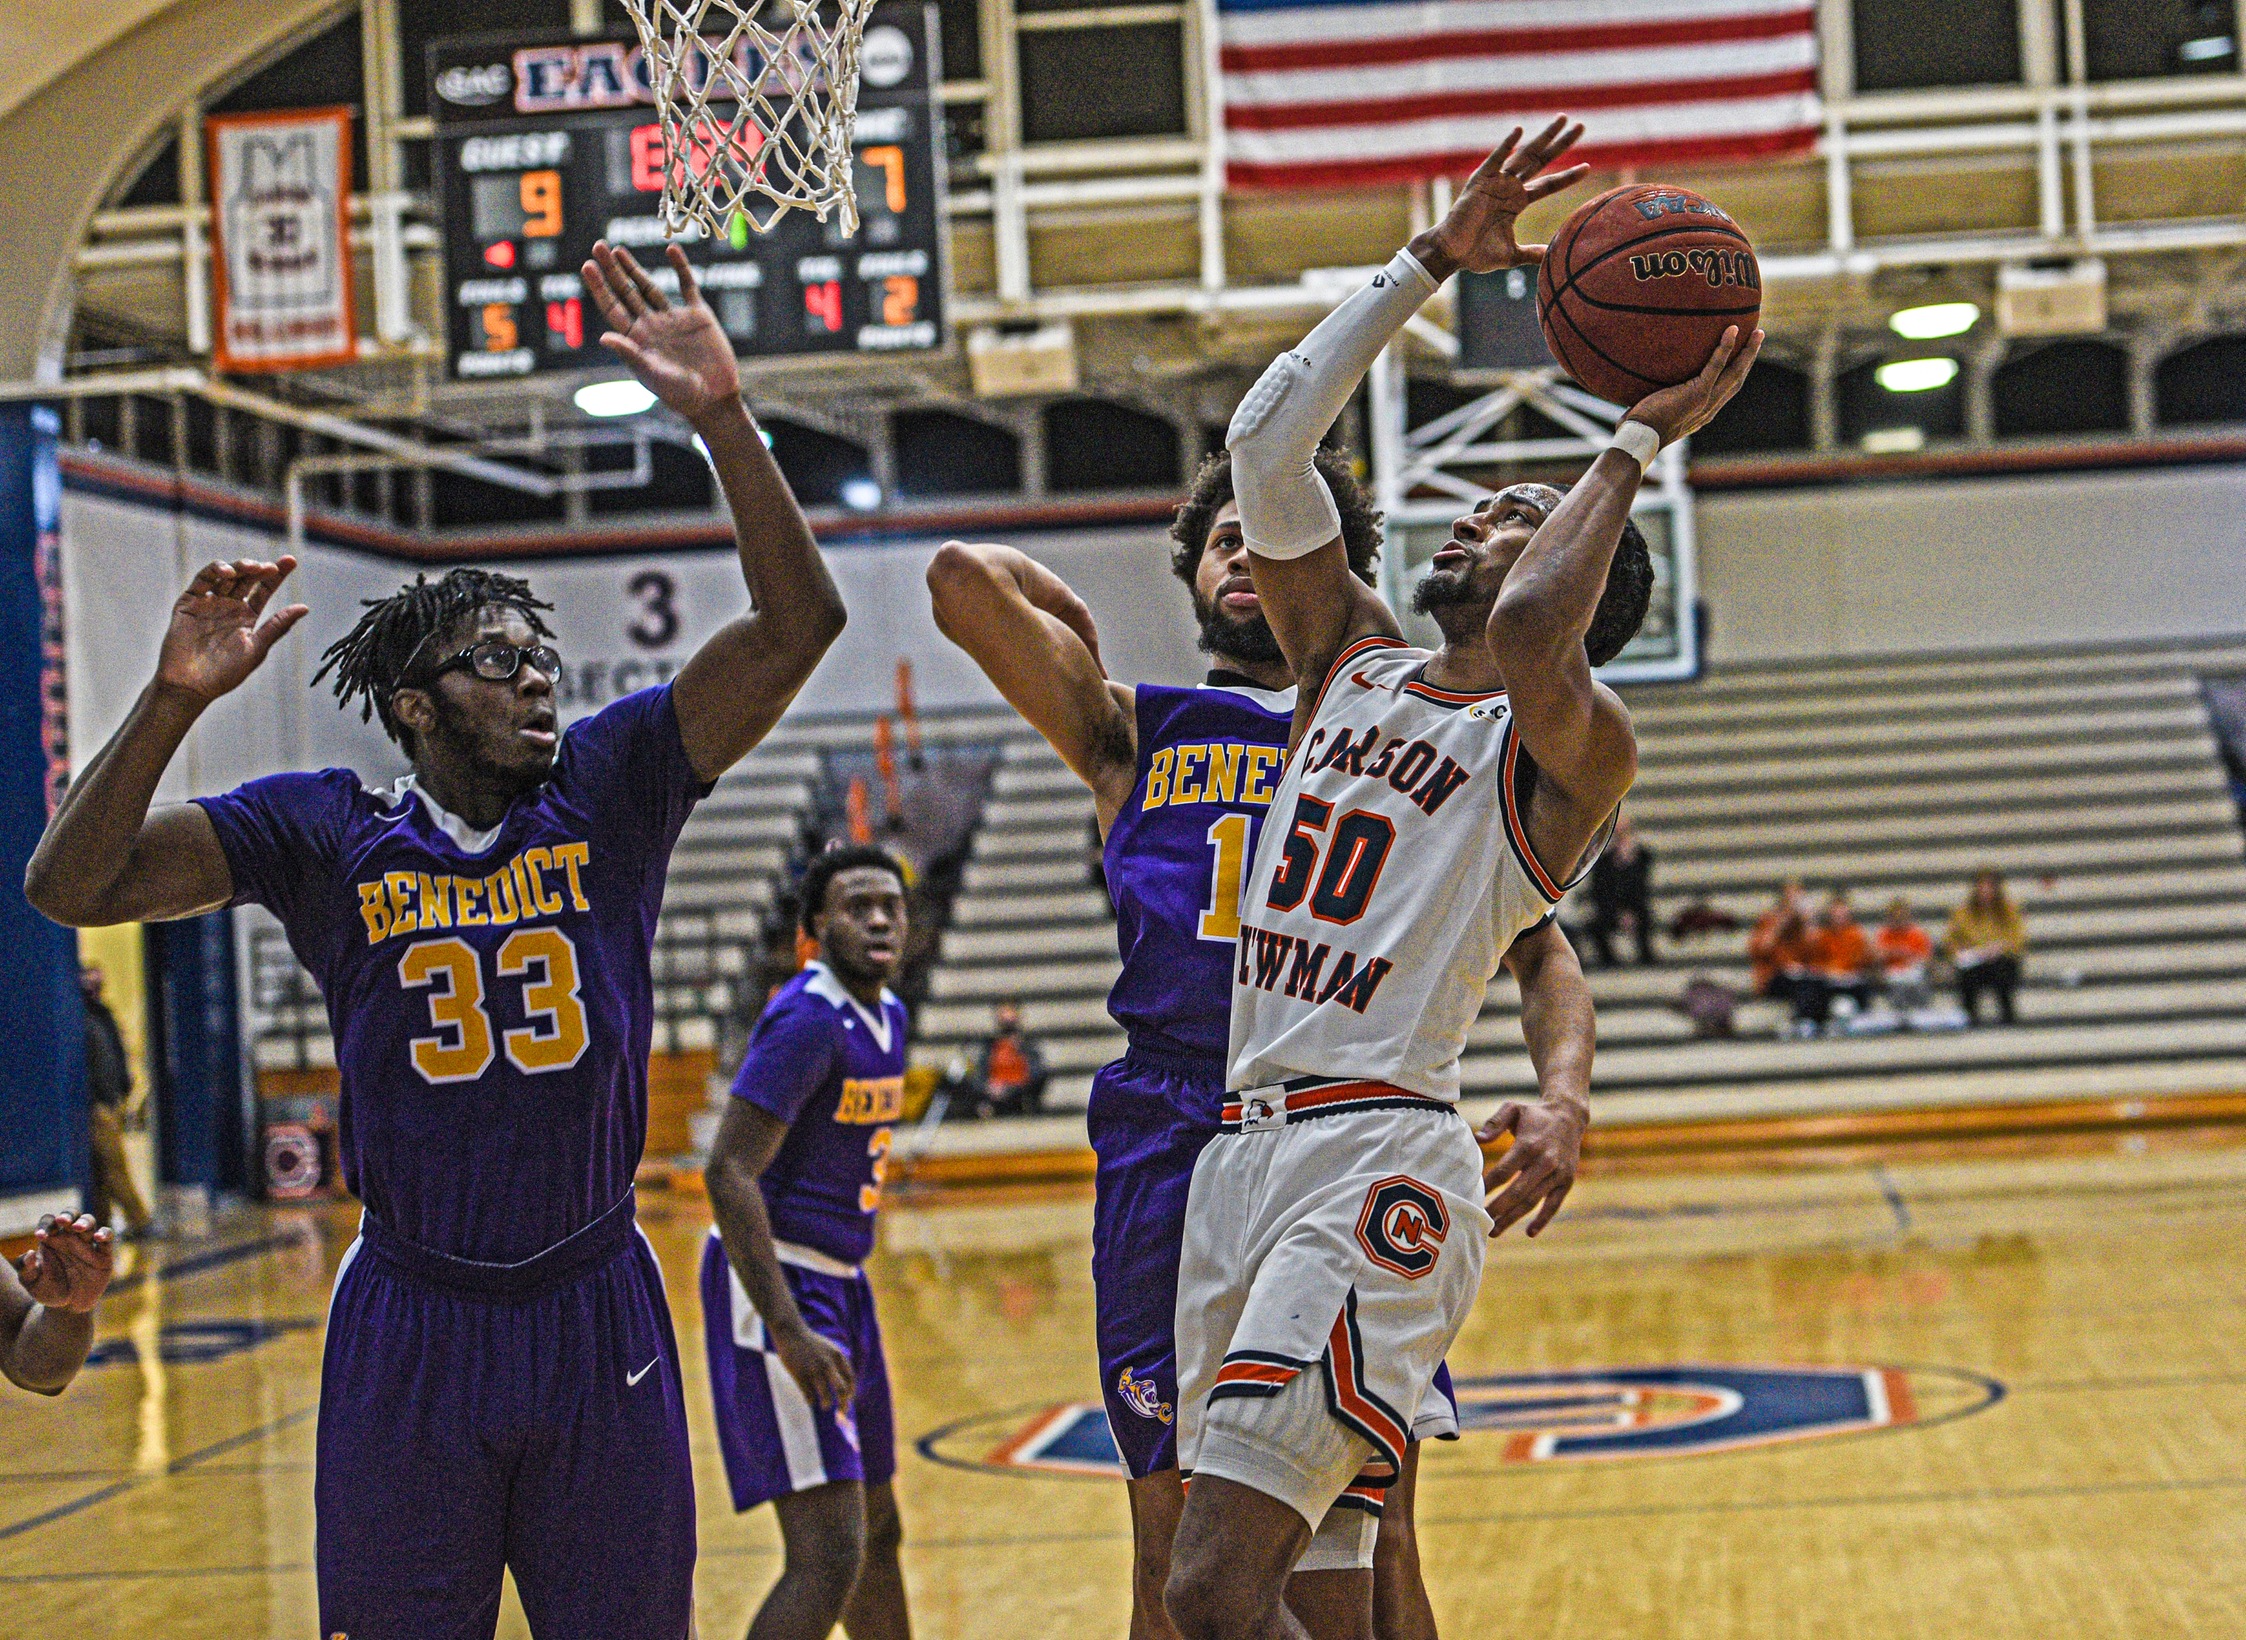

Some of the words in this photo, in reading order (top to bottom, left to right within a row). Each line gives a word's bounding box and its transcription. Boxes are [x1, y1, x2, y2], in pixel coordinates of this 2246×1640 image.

[519, 170, 563, 237] 9
[860, 144, 907, 213] 7
[882, 274, 919, 327] 2
[1629, 249, 1760, 292] Wilson
[481, 303, 518, 353] 5
[546, 297, 583, 349] 4
[804, 278, 843, 332] 4
[627, 571, 679, 649] 3
[1301, 725, 1471, 817] CARSON
[358, 841, 591, 945] BENEDICT
[1265, 792, 1397, 927] 50
[397, 925, 591, 1086] 33
